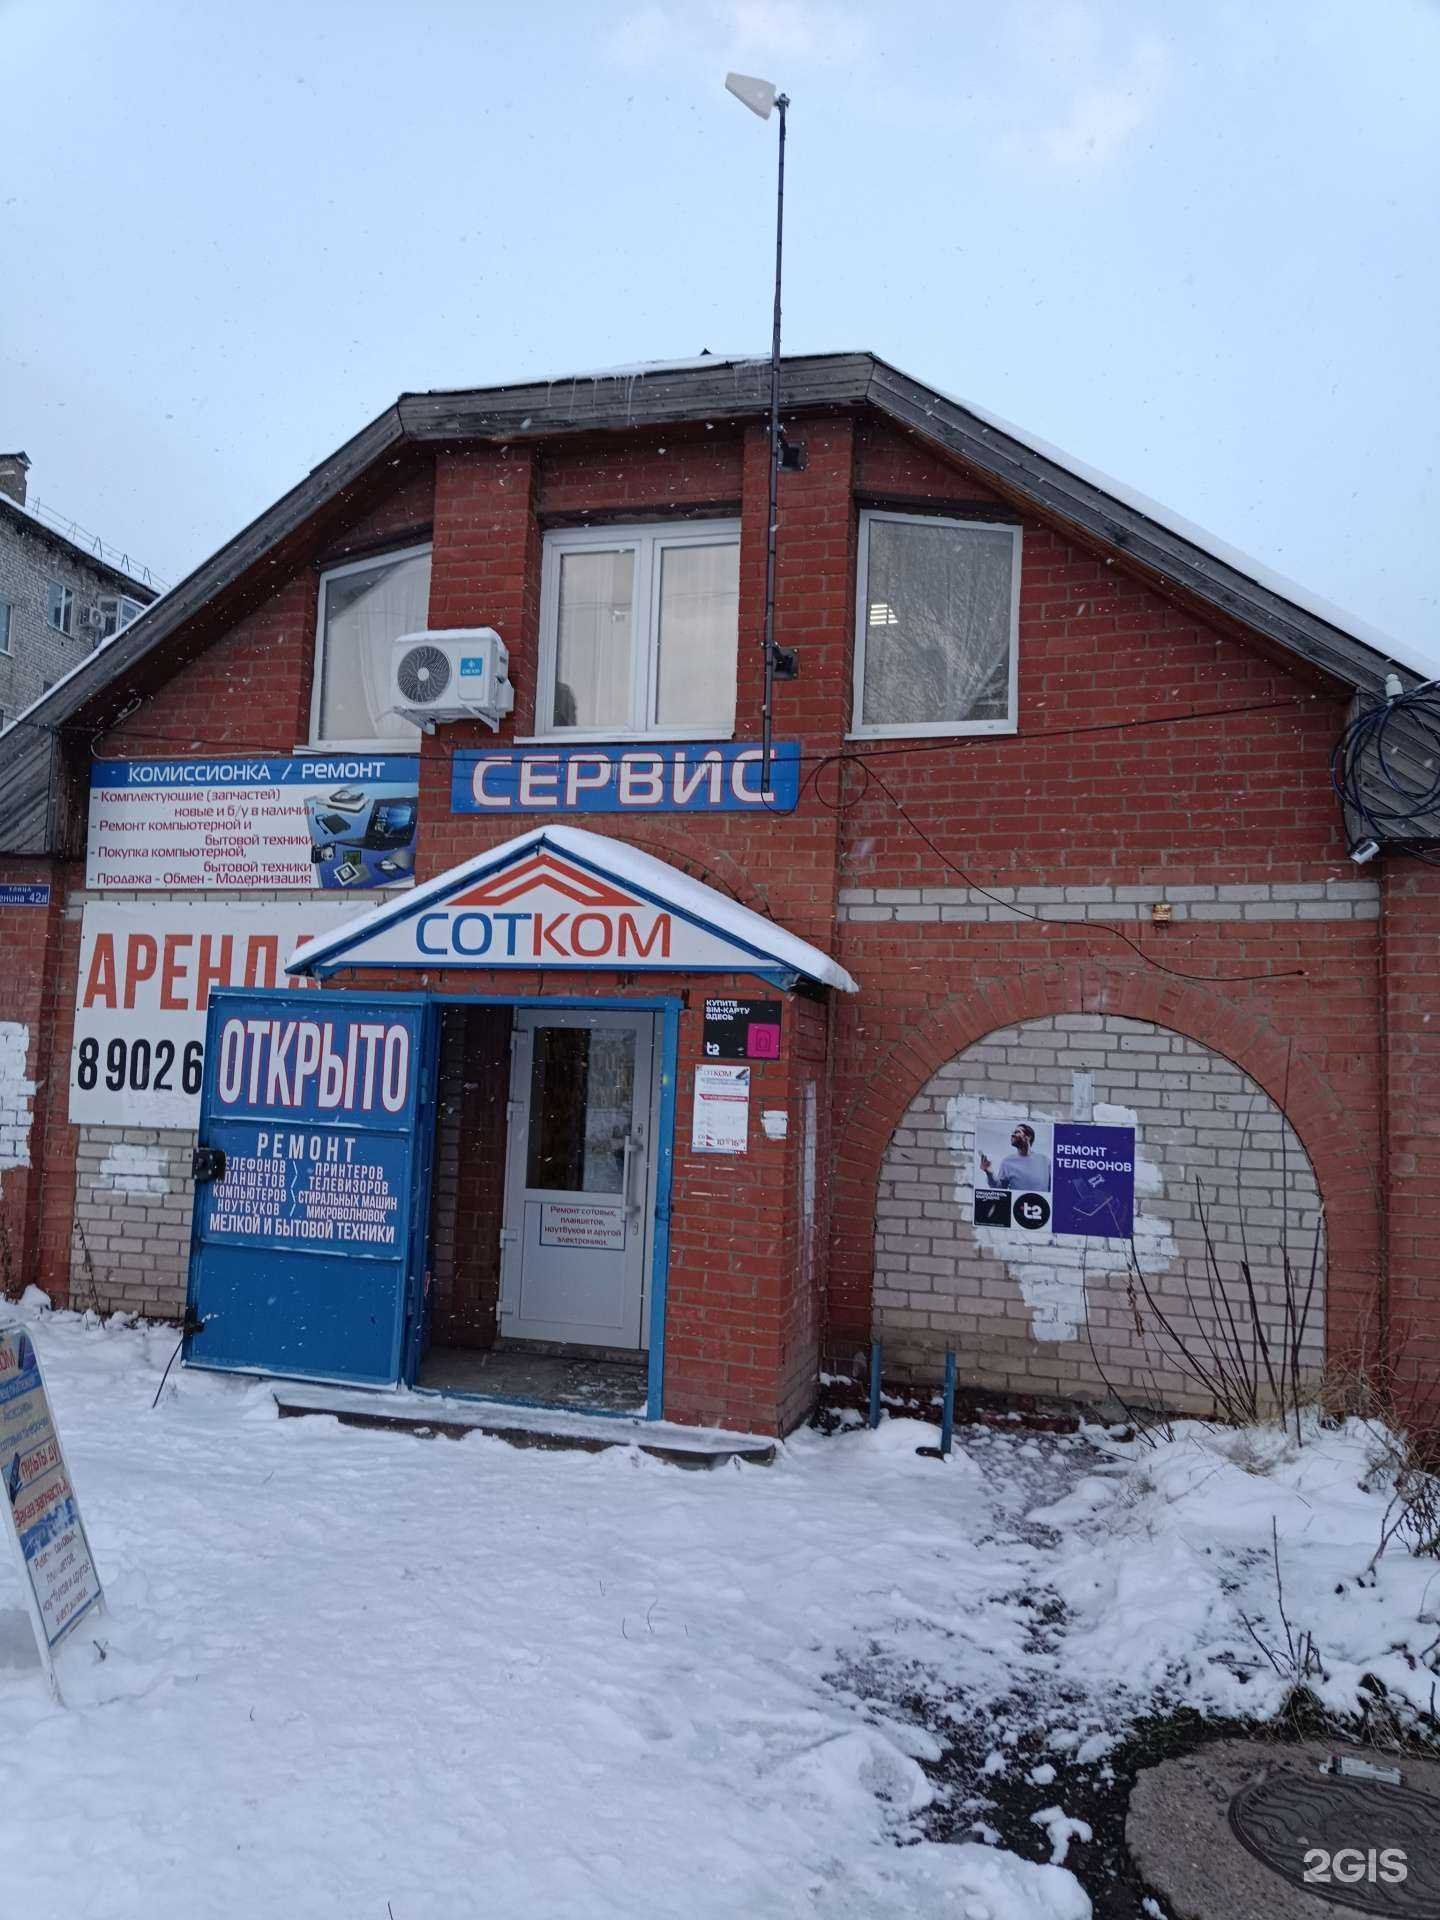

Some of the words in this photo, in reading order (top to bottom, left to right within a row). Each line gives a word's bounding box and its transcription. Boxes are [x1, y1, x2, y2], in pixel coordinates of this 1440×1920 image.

[128, 764, 271, 782] КОМИССИОНКА
[471, 748, 776, 807] СЕРВИС
[207, 788, 280, 803] (запчастей)
[175, 807, 214, 817] новые
[216, 807, 224, 816] и
[227, 804, 249, 818] б/у
[252, 807, 259, 816] в
[262, 806, 315, 817] наличии
[100, 820, 146, 831] Ремонт
[148, 817, 241, 832] компьютерной
[244, 820, 252, 830] и
[205, 833, 260, 846] бытовой
[263, 834, 313, 846] техники
[98, 846, 149, 859] Покупка
[203, 860, 258, 872] бытовой
[261, 862, 312, 872] техники
[97, 872, 152, 885] Продажа
[163, 872, 205, 884] Обмен
[216, 872, 312, 886] Модернизация
[0, 894, 25, 903] енина
[416, 912, 671, 958] СОТКОМ
[83, 933, 321, 1011] АРЕНД
[219, 1018, 410, 1113] ОТКРЫТО
[257, 1132, 356, 1162] РЕМОНТ
[1056, 1144, 1107, 1157] РЕМОНТ
[225, 1156, 286, 1173] ЕЛЕФОНОВ
[315, 1162, 384, 1180] ПРИНТЕРОВ
[1056, 1158, 1132, 1172] ТЕЛЕФОНОВ
[216, 1170, 286, 1188] ЛАНШЕТОВ
[308, 1176, 389, 1195] ТЕЛЕВИЗОРОВ
[212, 1184, 287, 1202] КОМПЬЮТЕРОВ
[298, 1190, 359, 1208] СТИРАЛЬНЫХ
[361, 1194, 398, 1210] МАШИН
[217, 1199, 281, 1216] НОУТБУКОВ
[306, 1205, 387, 1223] МИКРОВОЛНОВОК
[550, 1206, 579, 1214] Ремонт
[210, 1213, 260, 1234] МЕЛКОЙ
[263, 1218, 272, 1235] И
[275, 1218, 333, 1239] БЫТОВОЙ
[337, 1223, 395, 1244] ТЕХНИКИ
[544, 1226, 586, 1236] ноутбуков
